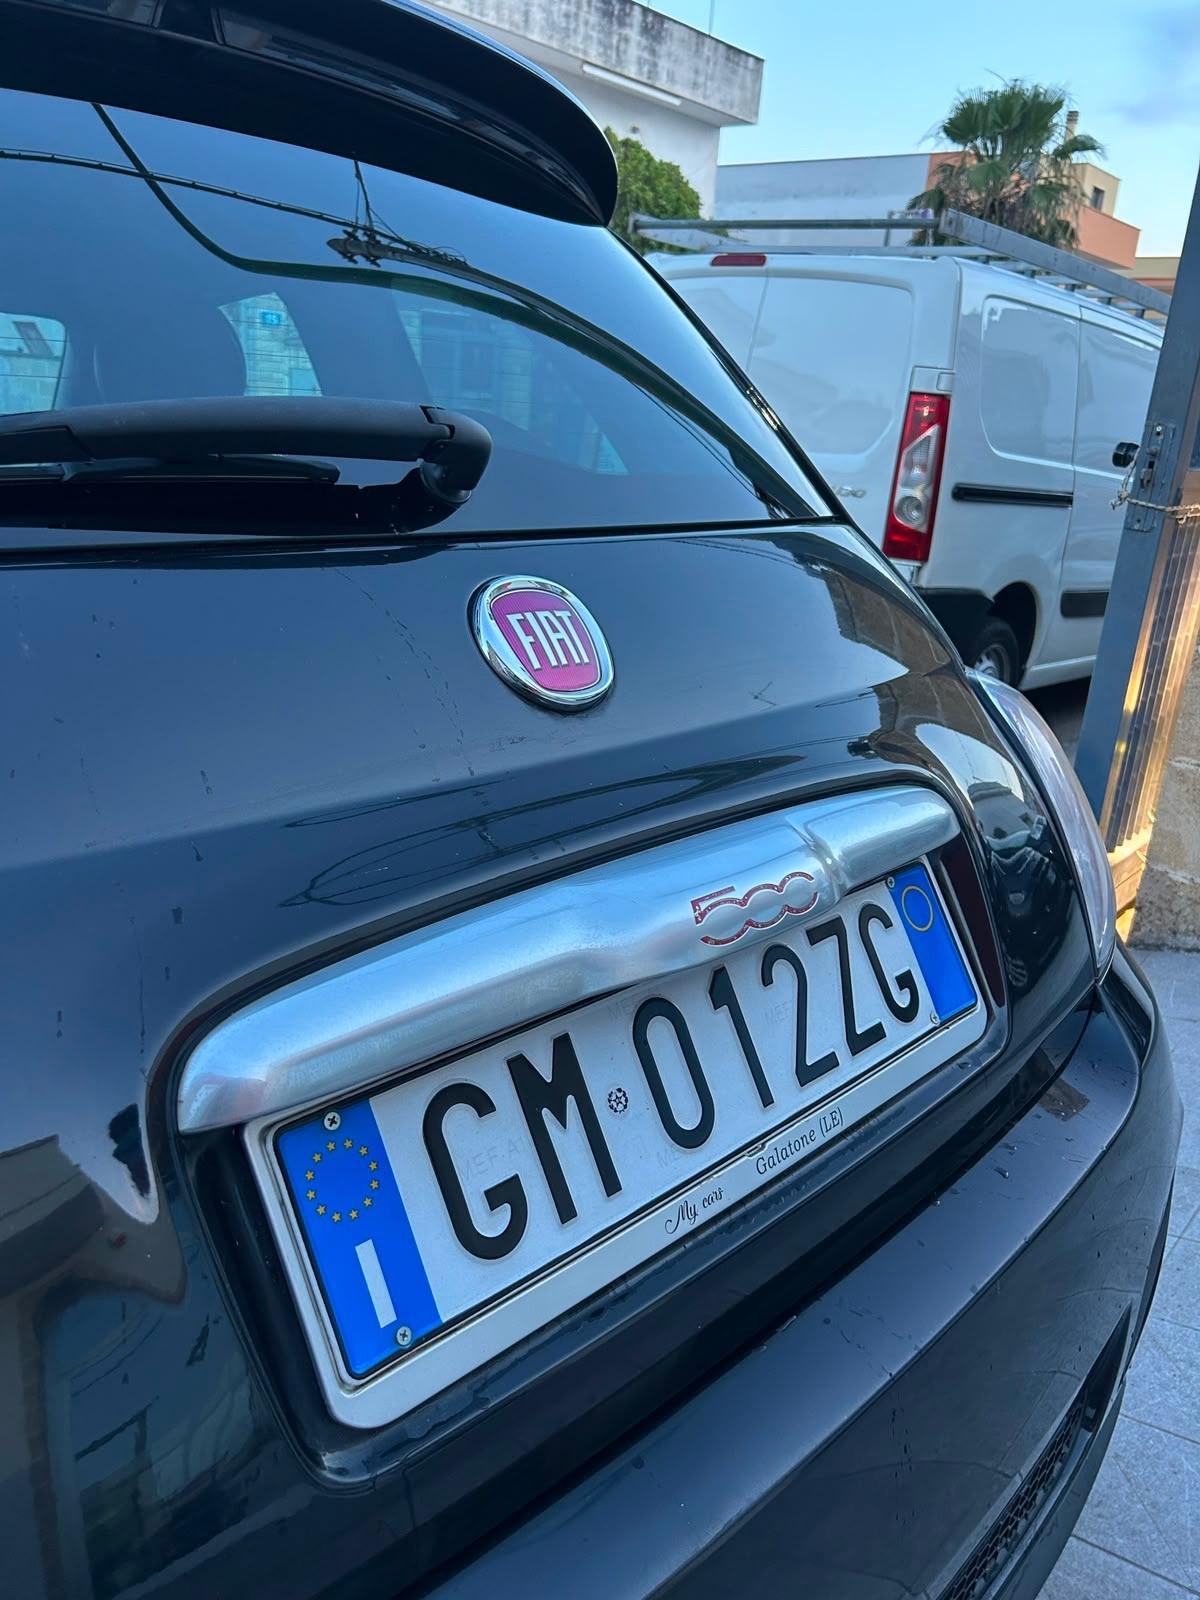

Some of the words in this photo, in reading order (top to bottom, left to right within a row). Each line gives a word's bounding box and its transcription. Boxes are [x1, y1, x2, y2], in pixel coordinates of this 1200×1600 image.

[506, 610, 590, 671] FIAT
[690, 871, 820, 948] 500
[664, 1200, 699, 1235] My
[755, 1127, 817, 1176] Galatone
[819, 1106, 845, 1138] (LE)
[354, 1239, 398, 1330] I
